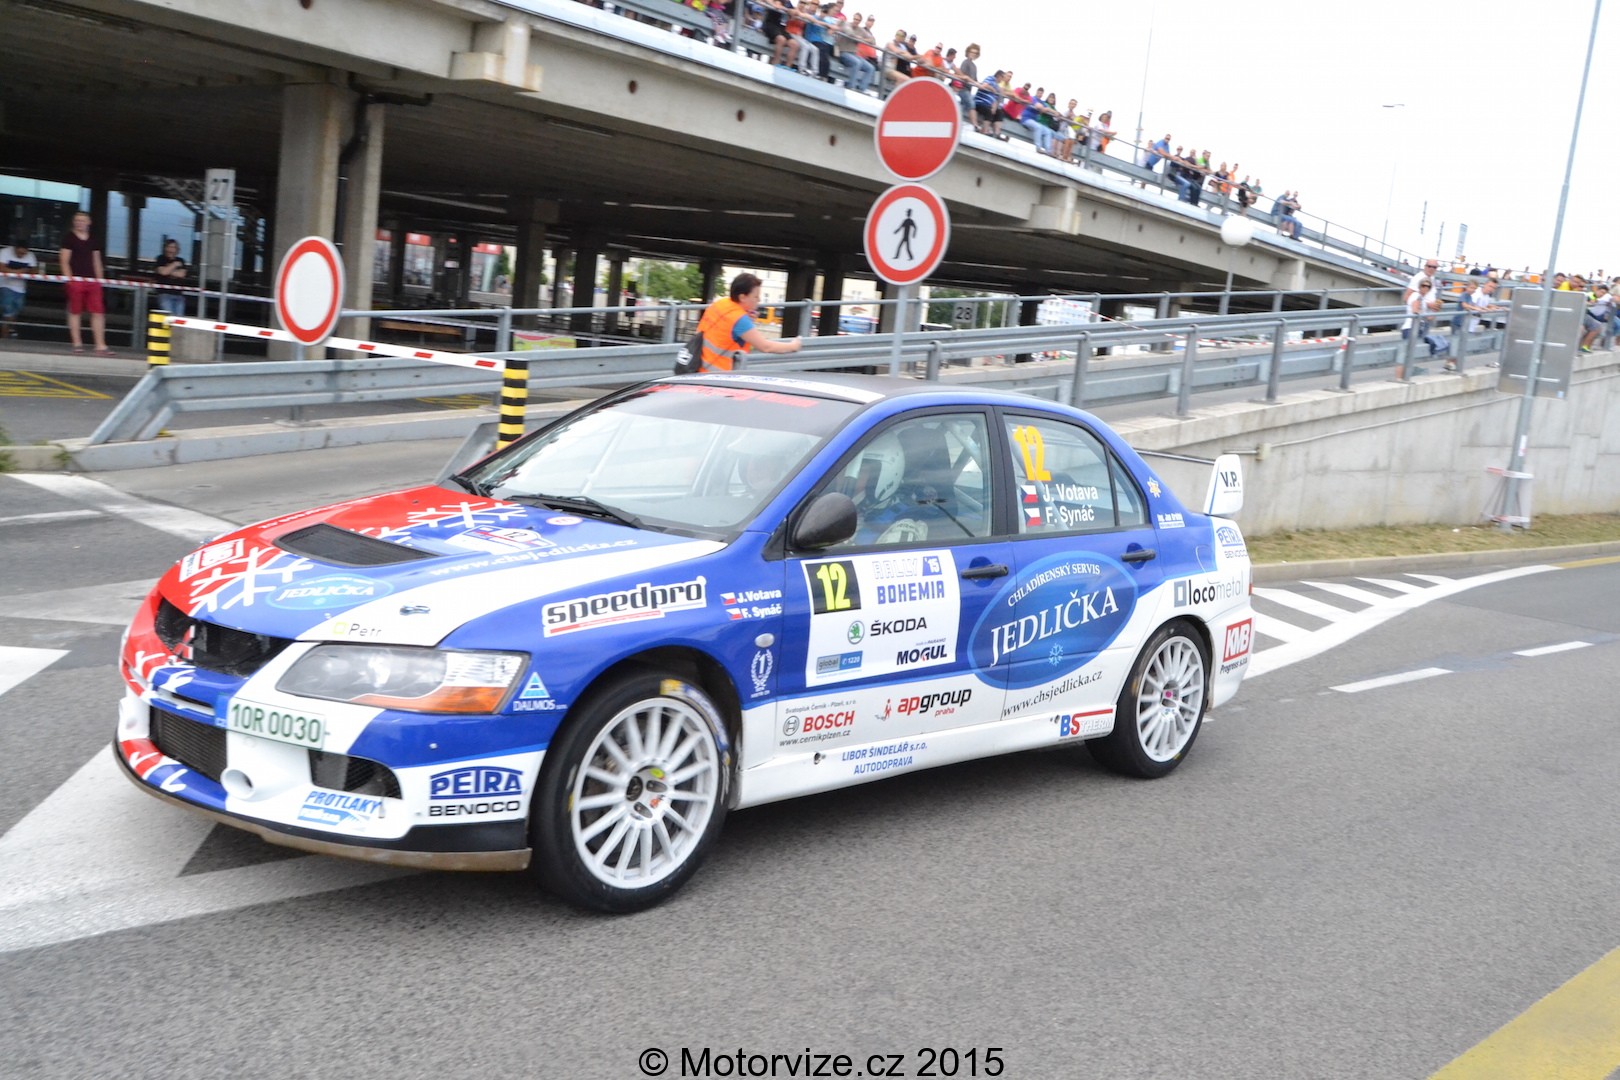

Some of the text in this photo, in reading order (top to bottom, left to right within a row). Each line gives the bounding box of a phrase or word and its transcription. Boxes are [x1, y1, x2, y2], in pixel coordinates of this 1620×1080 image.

[210, 178, 229, 200] 27
[956, 306, 973, 321] 28
[1012, 425, 1052, 481] 12
[1220, 471, 1240, 488] V.P.
[1043, 484, 1098, 502] J. Votava
[1046, 504, 1095, 527] F. Synáč
[1217, 528, 1243, 546] PETRA
[872, 558, 918, 580] RALLY
[816, 563, 850, 611] 12
[877, 580, 945, 605] BOHEMIA
[1007, 562, 1100, 607] CHLADÍRENSKÝ SERVIS
[1188, 571, 1244, 606] locometal
[547, 582, 703, 625] speedpro
[742, 603, 782, 618] F. Synáč
[349, 623, 382, 637] Petr
[870, 616, 927, 637] ŠKODA
[990, 586, 1119, 668] JEDLIČKA
[1227, 624, 1249, 657] KMB
[896, 645, 948, 666] MOGUL
[513, 699, 555, 711] DALMOS
[898, 688, 972, 716] apgroup
[1003, 670, 1103, 718] www.chsjedlicka.cz
[232, 703, 321, 743] 10R 0030
[802, 710, 855, 733] BOSCH
[934, 707, 955, 718] praha
[842, 742, 928, 762] LIBOR ŠINDELÁŘ s.r.o.
[853, 756, 913, 775] AUTODOPRAVA
[430, 767, 522, 796] PETRA
[305, 791, 382, 814] PROTLAKY
[429, 800, 520, 817] BENOCO
